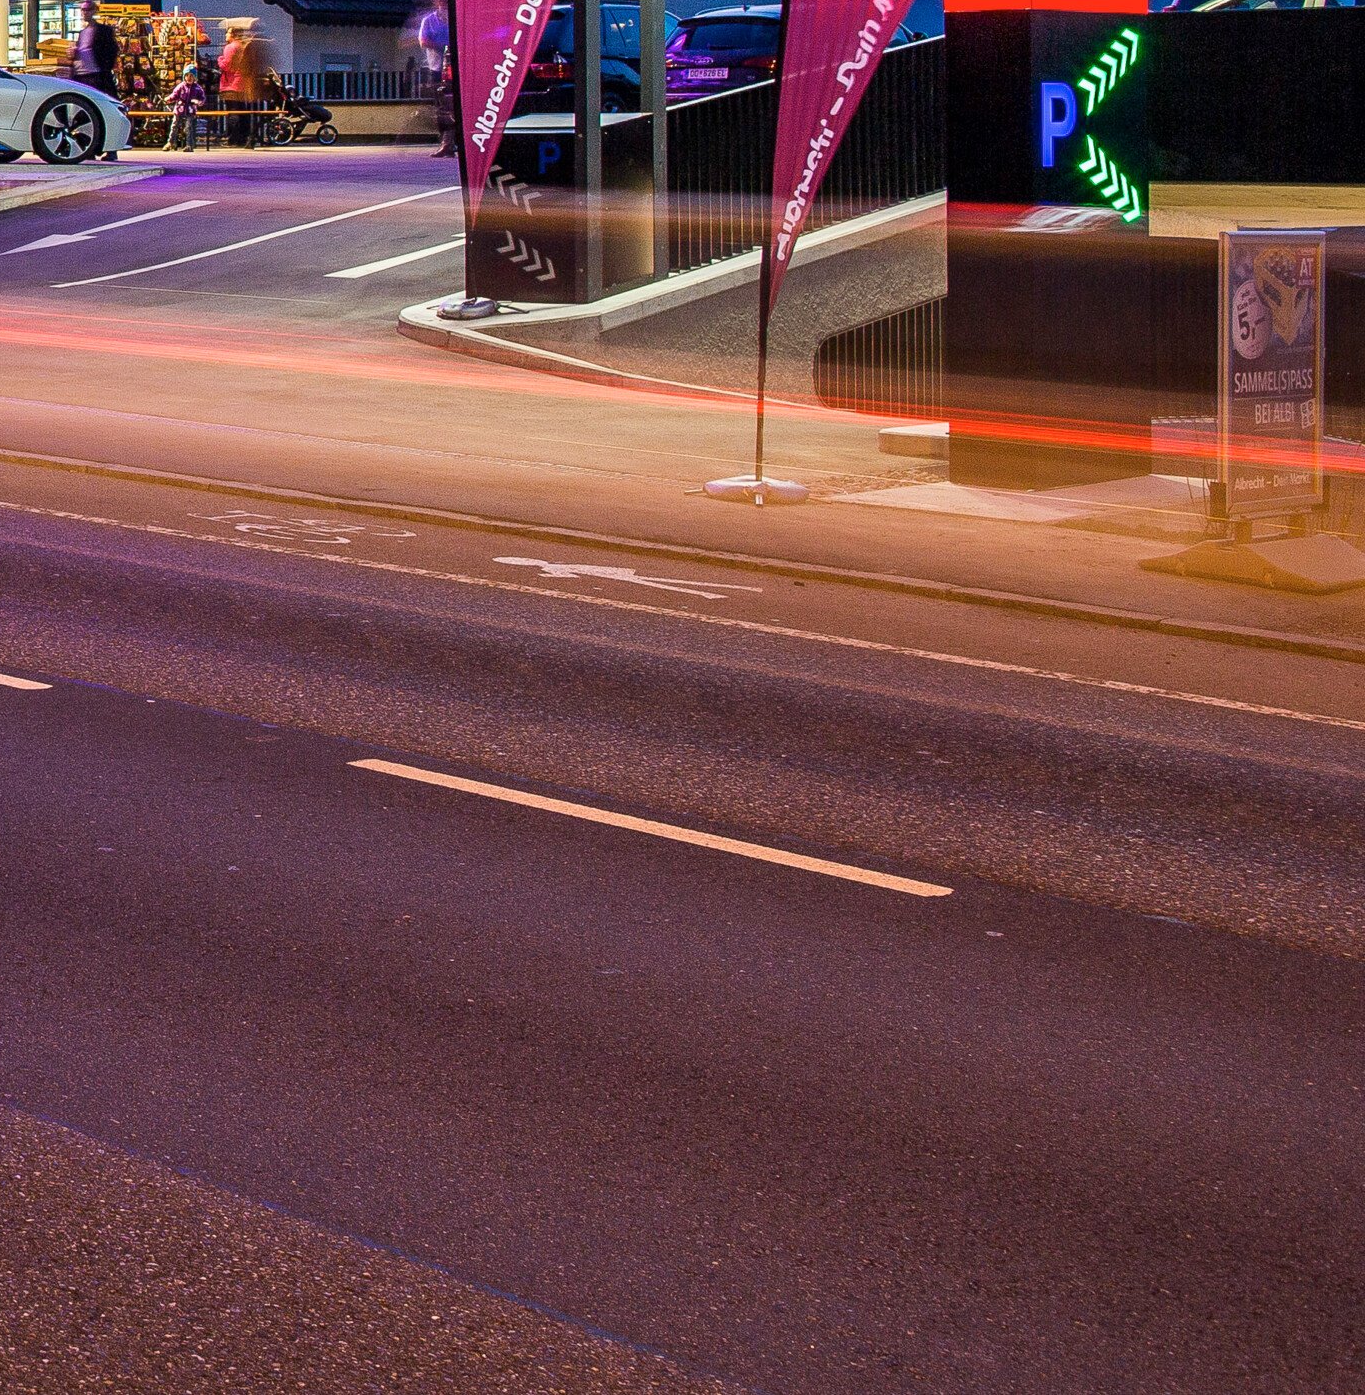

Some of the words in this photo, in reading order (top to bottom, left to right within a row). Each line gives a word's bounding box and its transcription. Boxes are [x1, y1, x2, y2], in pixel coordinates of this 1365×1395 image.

[471, 47, 518, 153] Albrecht
[1040, 80, 1077, 168] P
[538, 141, 561, 174] P
[1299, 257, 1314, 277] AT
[1234, 368, 1313, 394] SAMMEL(S)PASS
[1255, 404, 1271, 424] BEI
